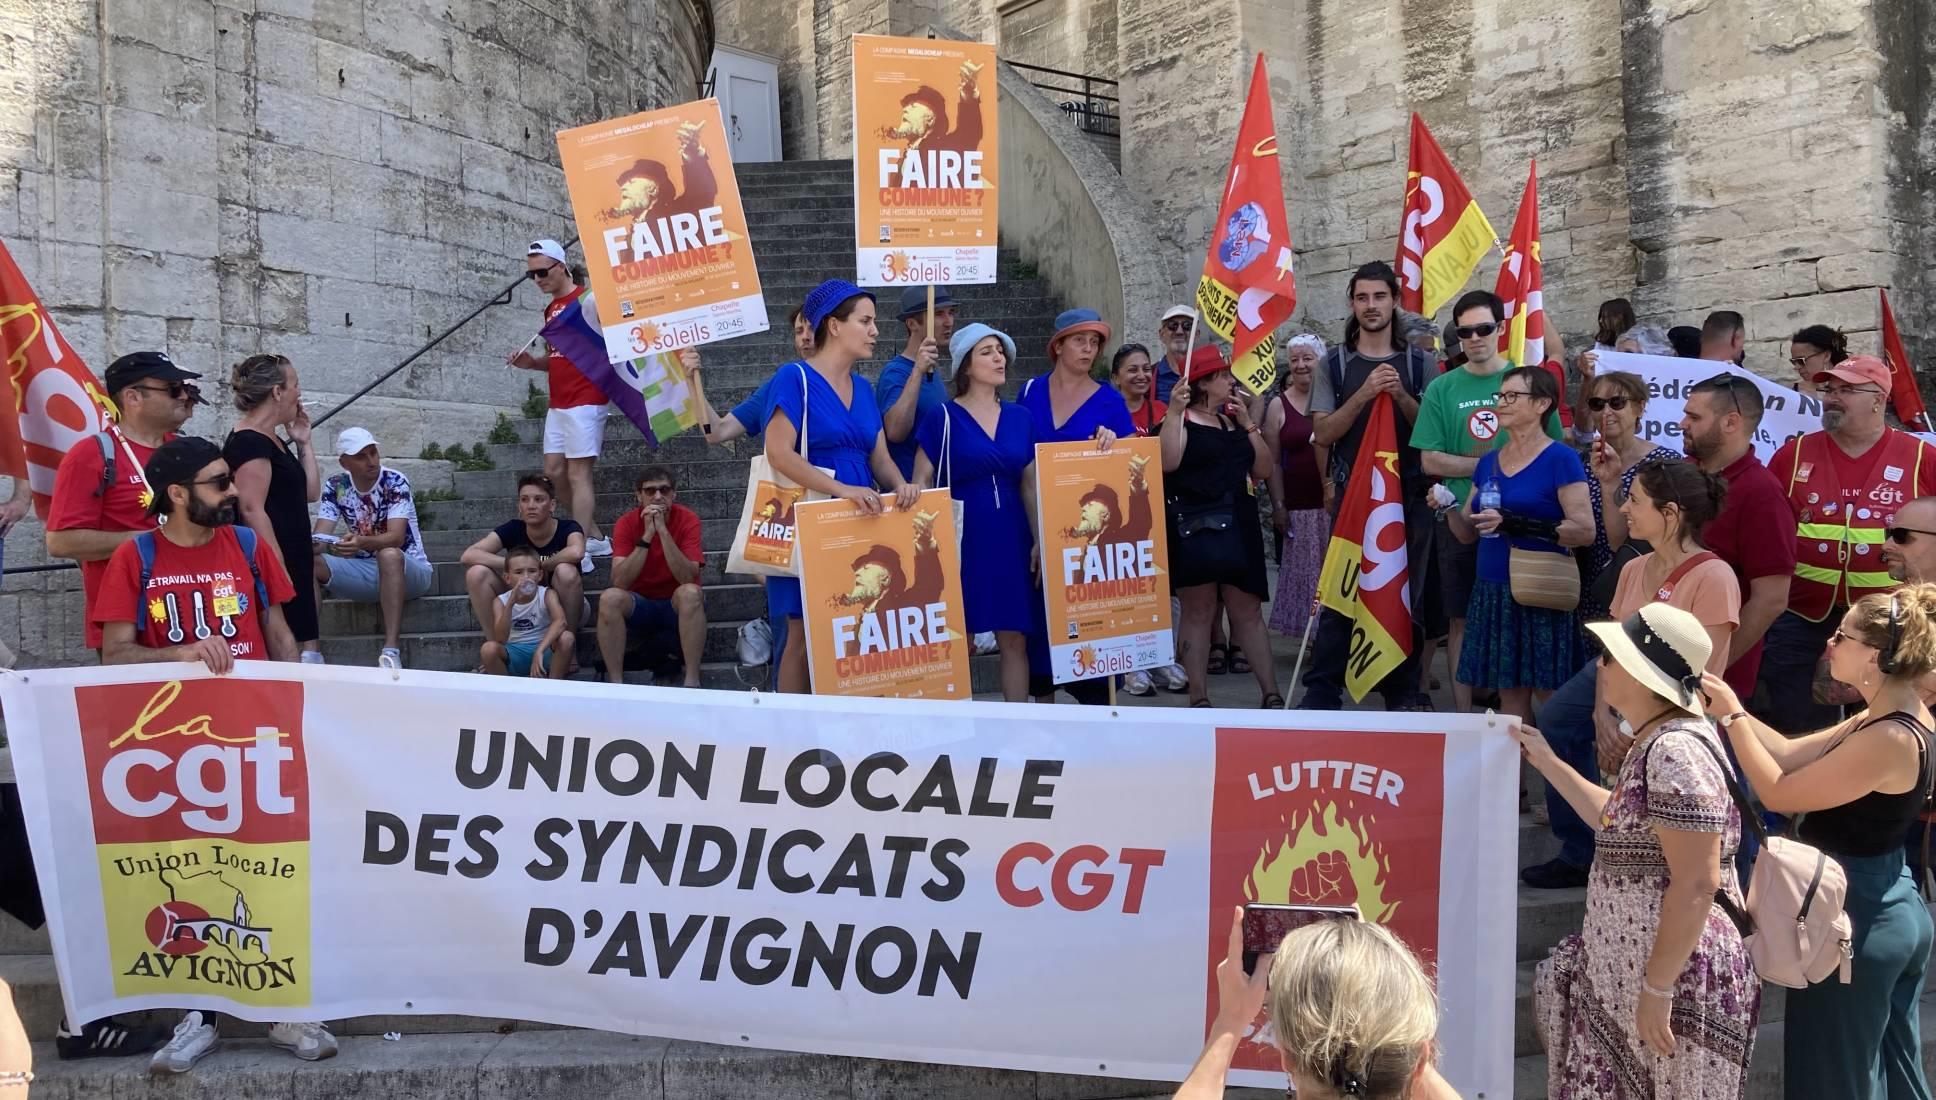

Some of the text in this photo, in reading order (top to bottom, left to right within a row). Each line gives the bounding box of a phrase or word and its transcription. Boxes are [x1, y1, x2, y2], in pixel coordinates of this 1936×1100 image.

[878, 149, 984, 189] FAIRE
[878, 188, 984, 207] COMMUNE ?
[880, 208, 891, 216] UNE
[893, 208, 916, 216] HISTOIRE
[918, 208, 926, 216] DU
[926, 208, 960, 216] MOUVEMENT
[602, 206, 730, 268] FAIRE
[611, 242, 732, 284] COMMUNE ?
[616, 282, 630, 292] UNE
[630, 278, 658, 291] HISTOIRE
[658, 276, 668, 284] DU
[668, 266, 708, 282] MOUVEMENT
[882, 254, 896, 282] 3
[901, 262, 950, 282] soleils
[630, 326, 648, 354] 3
[653, 324, 710, 350] soleils
[1458, 400, 1480, 408] SAVE
[1868, 488, 1904, 504] cgt
[750, 520, 794, 542] FAIRE
[156, 574, 196, 586] TRAVAIL
[196, 574, 212, 584] N'A
[214, 572, 234, 581] PAS
[1062, 540, 1156, 586] FAIRE
[214, 584, 234, 598] cgt
[1065, 576, 1158, 603] COMMUNE ?
[1658, 588, 1671, 600] cgt
[832, 602, 950, 660] FAIRE
[836, 641, 952, 678] COMMUNE ?
[1072, 649, 1086, 677] 3
[1090, 651, 1133, 675] soleils
[838, 680, 852, 688] UNE
[852, 676, 880, 686] HISTOIRE
[890, 668, 928, 679] MOUVEMENT
[109, 680, 290, 748] la
[102, 726, 296, 834] cgt
[455, 728, 1064, 820] UNION LOCALE
[1248, 760, 1404, 807] LUTTER
[114, 846, 296, 880] Union Locale
[362, 810, 1166, 914] DES SYNDICATS CGT
[524, 907, 982, 1000] D'AVIGNON
[123, 951, 297, 991] AVIGNON
